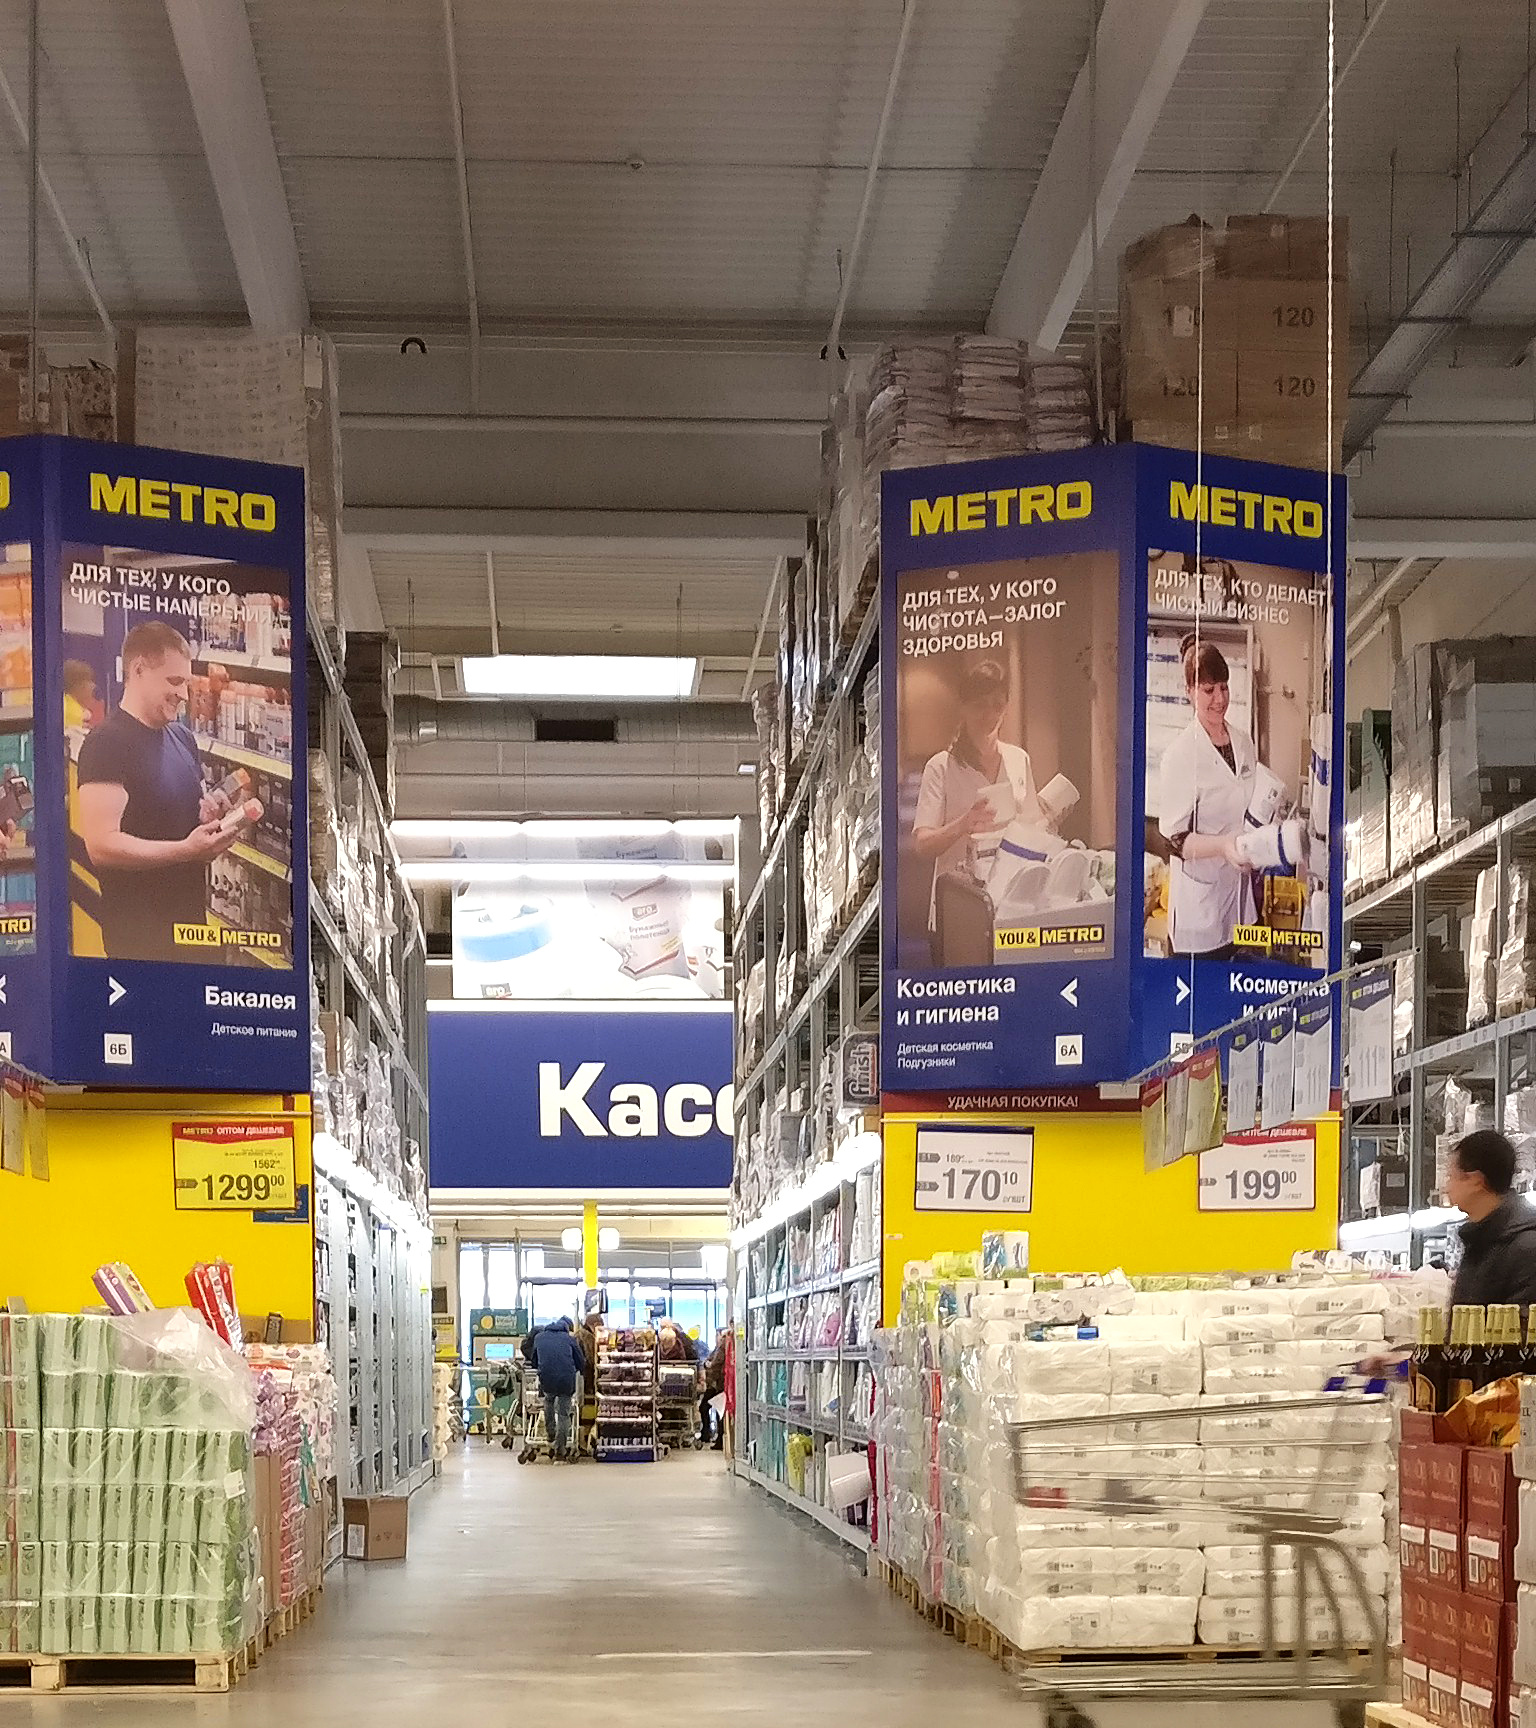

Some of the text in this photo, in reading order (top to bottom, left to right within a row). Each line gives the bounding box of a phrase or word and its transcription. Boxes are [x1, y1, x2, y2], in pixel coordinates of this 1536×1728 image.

[1272, 306, 1315, 328] 120
[1272, 376, 1316, 398] 120
[89, 471, 276, 533] METRO
[909, 479, 1092, 537] METRO
[1169, 479, 1324, 539] METRO
[69, 561, 231, 596] ДЛЯ ТЕХ, У КОГО
[1155, 569, 1328, 608] ДЛЯ КТО ДЕЛАЕТ
[69, 588, 274, 624] ЧИСТЫЕ НАМЕРЕНИЯ
[901, 576, 1057, 613] ДЛЯ ТЕХ, У КОГО
[1226, 602, 1290, 626] БИЗНЕС
[901, 630, 1004, 658] ЗДОРОВЬЯ
[176, 926, 281, 947] YOU METRO
[998, 925, 1103, 947] YOU & METRO
[1235, 927, 1322, 947] YOU METRO
[896, 976, 1017, 1000] Косметика
[1229, 972, 1330, 998] Косметика
[204, 985, 296, 1011] Бакалея
[897, 1005, 999, 1026] и гигиена
[210, 1020, 298, 1039] Детское питание
[897, 1040, 994, 1056] Детская косметика
[1060, 1043, 1078, 1057] 6А
[897, 1056, 956, 1070] Подгузники
[946, 1095, 1079, 1109] УДАЧНАЯ ПОКУПКА!
[201, 1173, 285, 1201] 1299 00
[942, 1167, 1018, 1201] 170 10
[1224, 1169, 1297, 1201] 199 00
